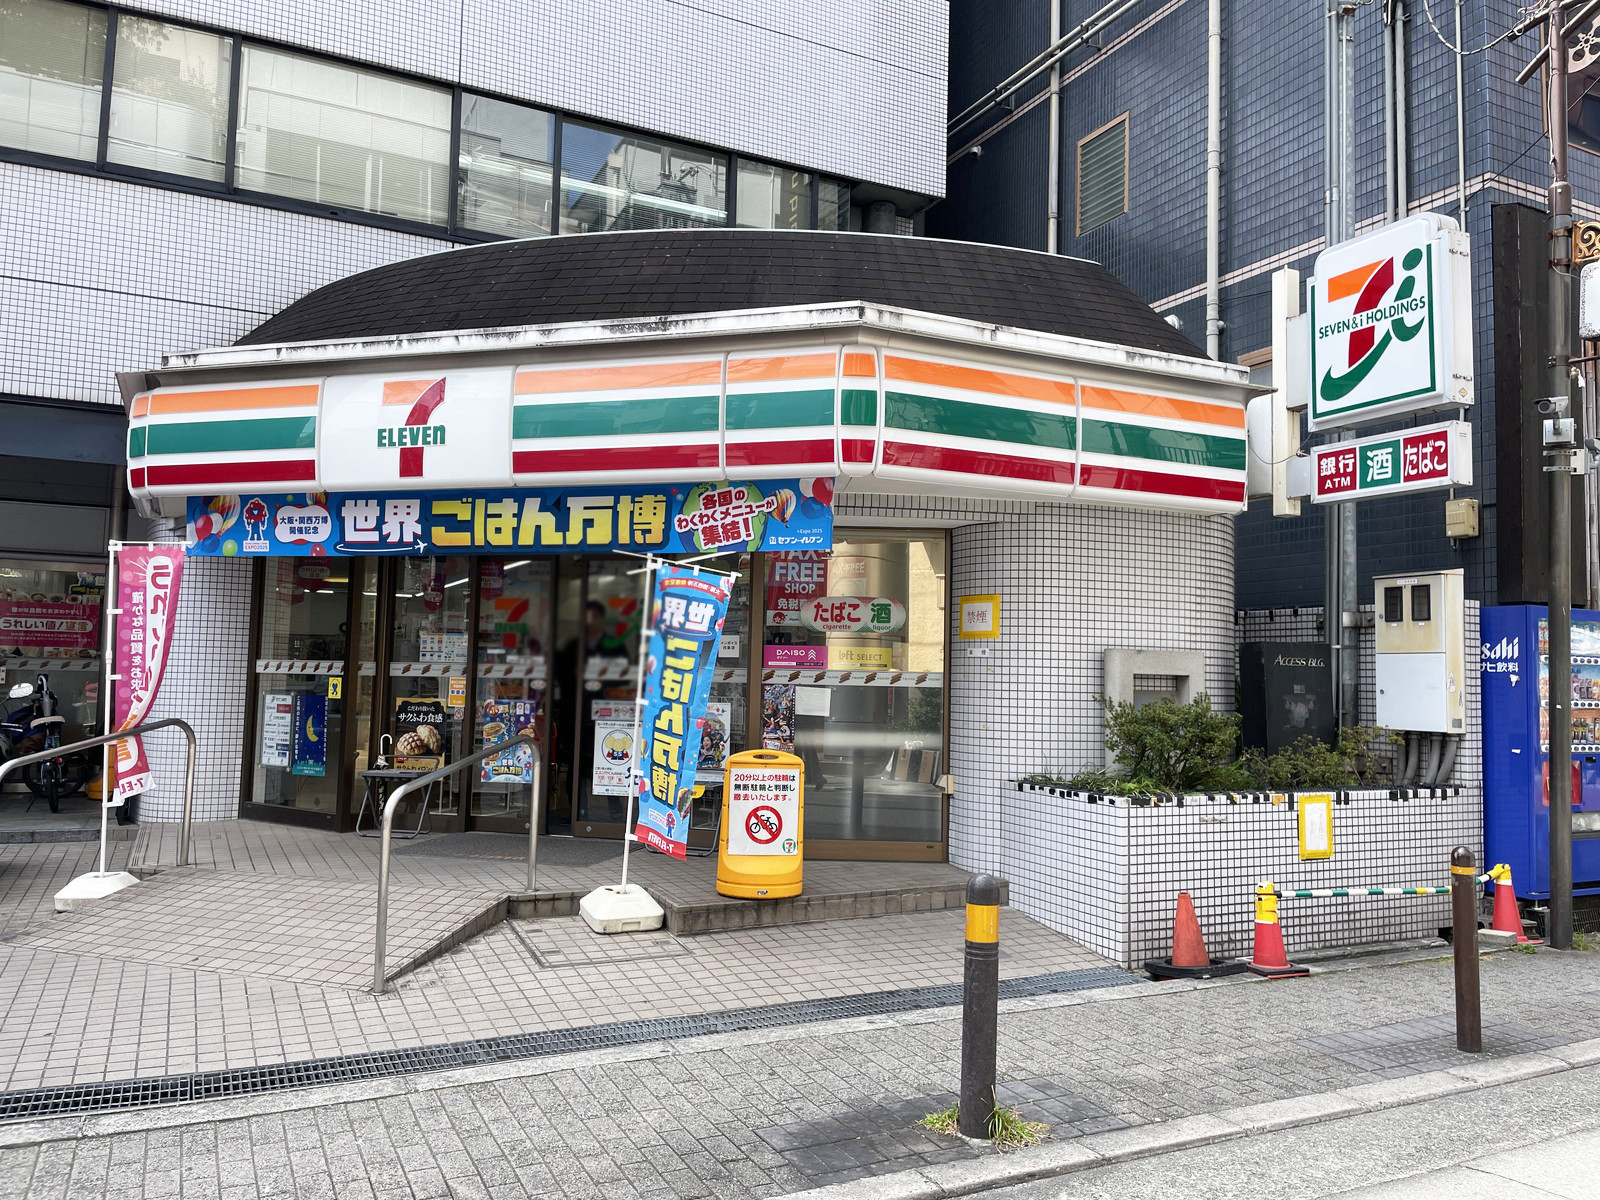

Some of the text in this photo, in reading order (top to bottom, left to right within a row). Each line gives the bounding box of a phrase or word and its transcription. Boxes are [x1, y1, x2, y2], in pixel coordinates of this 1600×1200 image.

[1366, 296, 1426, 325] HOLDINGS
[1366, 447, 1393, 482] 酒
[1405, 440, 1447, 476] たばこ
[1320, 454, 1355, 476] 銀行
[1325, 476, 1350, 489] ATM
[702, 489, 745, 510] 各国の
[676, 498, 775, 530] わくわくメニューが
[279, 516, 328, 526] 大阪・関西万博
[289, 526, 320, 535] 開催記念
[774, 561, 825, 582] FREE
[784, 583, 816, 594] SHOP
[813, 602, 892, 624] たばこ 酒
[1273, 653, 1307, 666] ACCESS
[398, 712, 443, 722] サクふわ食感
[734, 773, 796, 782] 20分以上の駐輪は
[733, 783, 796, 792] 無断駐輪と判断し
[733, 793, 792, 802] 撤去いたします。
